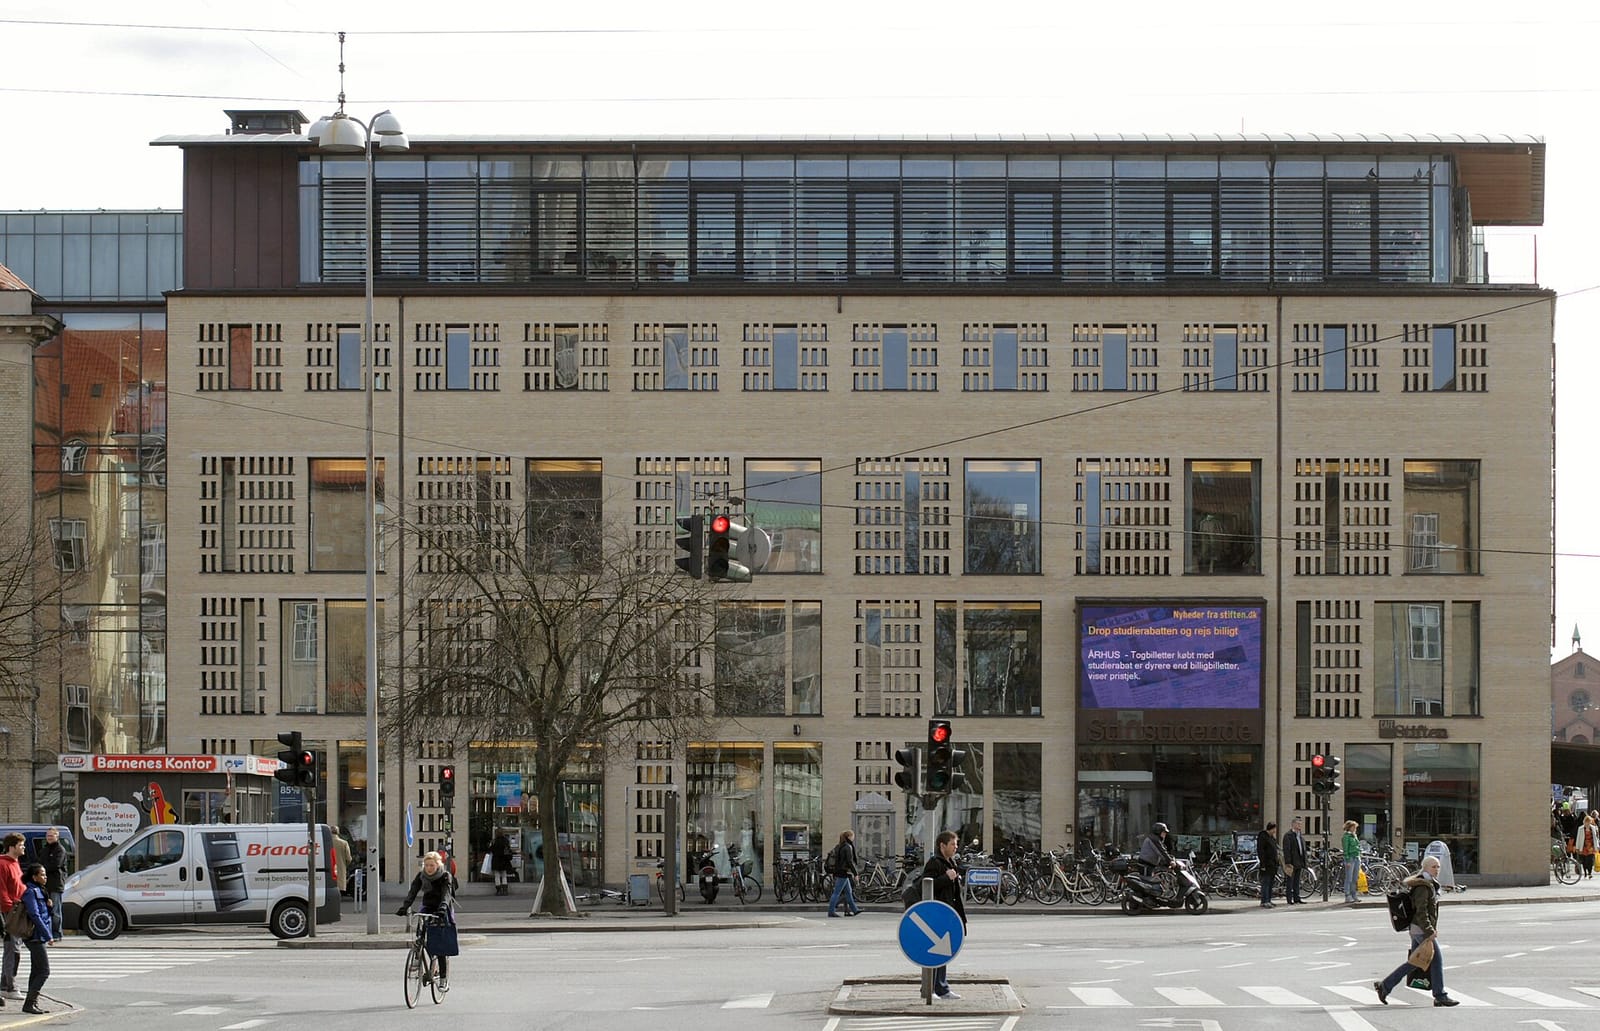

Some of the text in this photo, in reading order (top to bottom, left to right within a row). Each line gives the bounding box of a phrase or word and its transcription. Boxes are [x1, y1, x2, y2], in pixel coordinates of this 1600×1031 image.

[1173, 610, 1257, 620] Nyheder fra stiften.dk
[1088, 626, 1239, 637] Drop studierabatten og rejs billigt
[1088, 649, 1120, 659] ÅRHUS
[1131, 650, 1175, 661] Togbilletter
[1177, 650, 1194, 660] købt
[1197, 650, 1214, 660] med
[1088, 661, 1132, 670] studierabat
[1145, 662, 1171, 671] dyrere
[1173, 661, 1188, 670] end
[1190, 661, 1240, 671] billigbilletter.
[1088, 671, 1141, 682] viser pristjek.
[97, 756, 162, 769] Børnenes
[165, 757, 212, 769] Kontor
